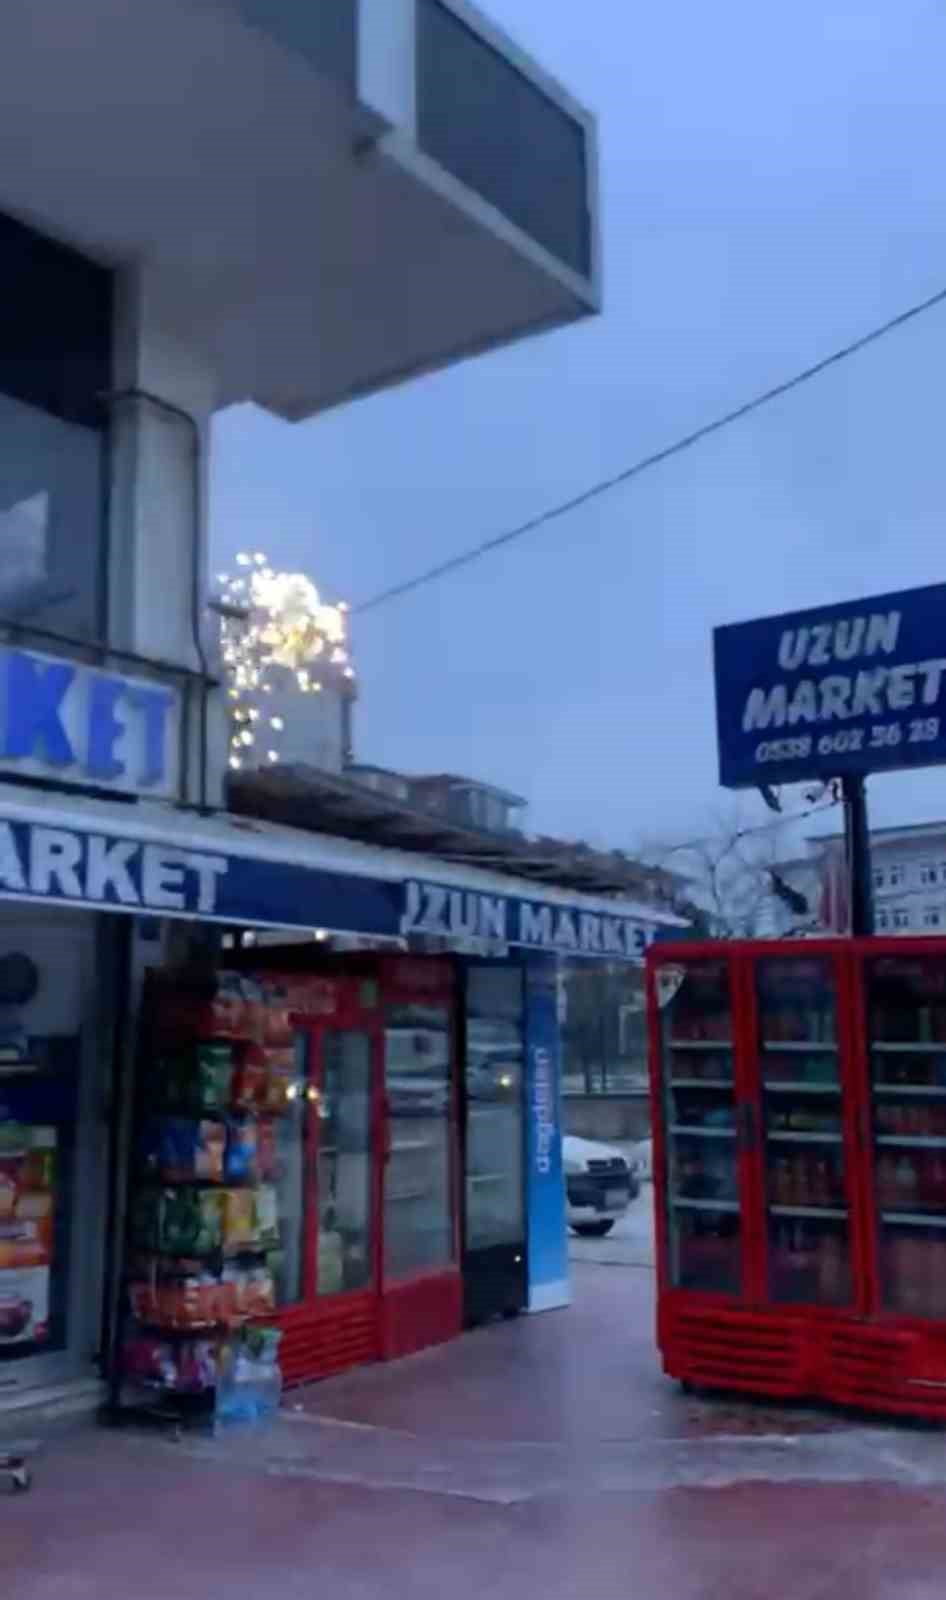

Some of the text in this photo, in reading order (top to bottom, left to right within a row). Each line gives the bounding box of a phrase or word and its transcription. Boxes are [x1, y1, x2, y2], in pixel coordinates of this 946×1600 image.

[778, 611, 901, 670] UZUN
[4, 653, 176, 786] KET
[742, 658, 946, 733] MARKET
[818, 729, 865, 755] 602
